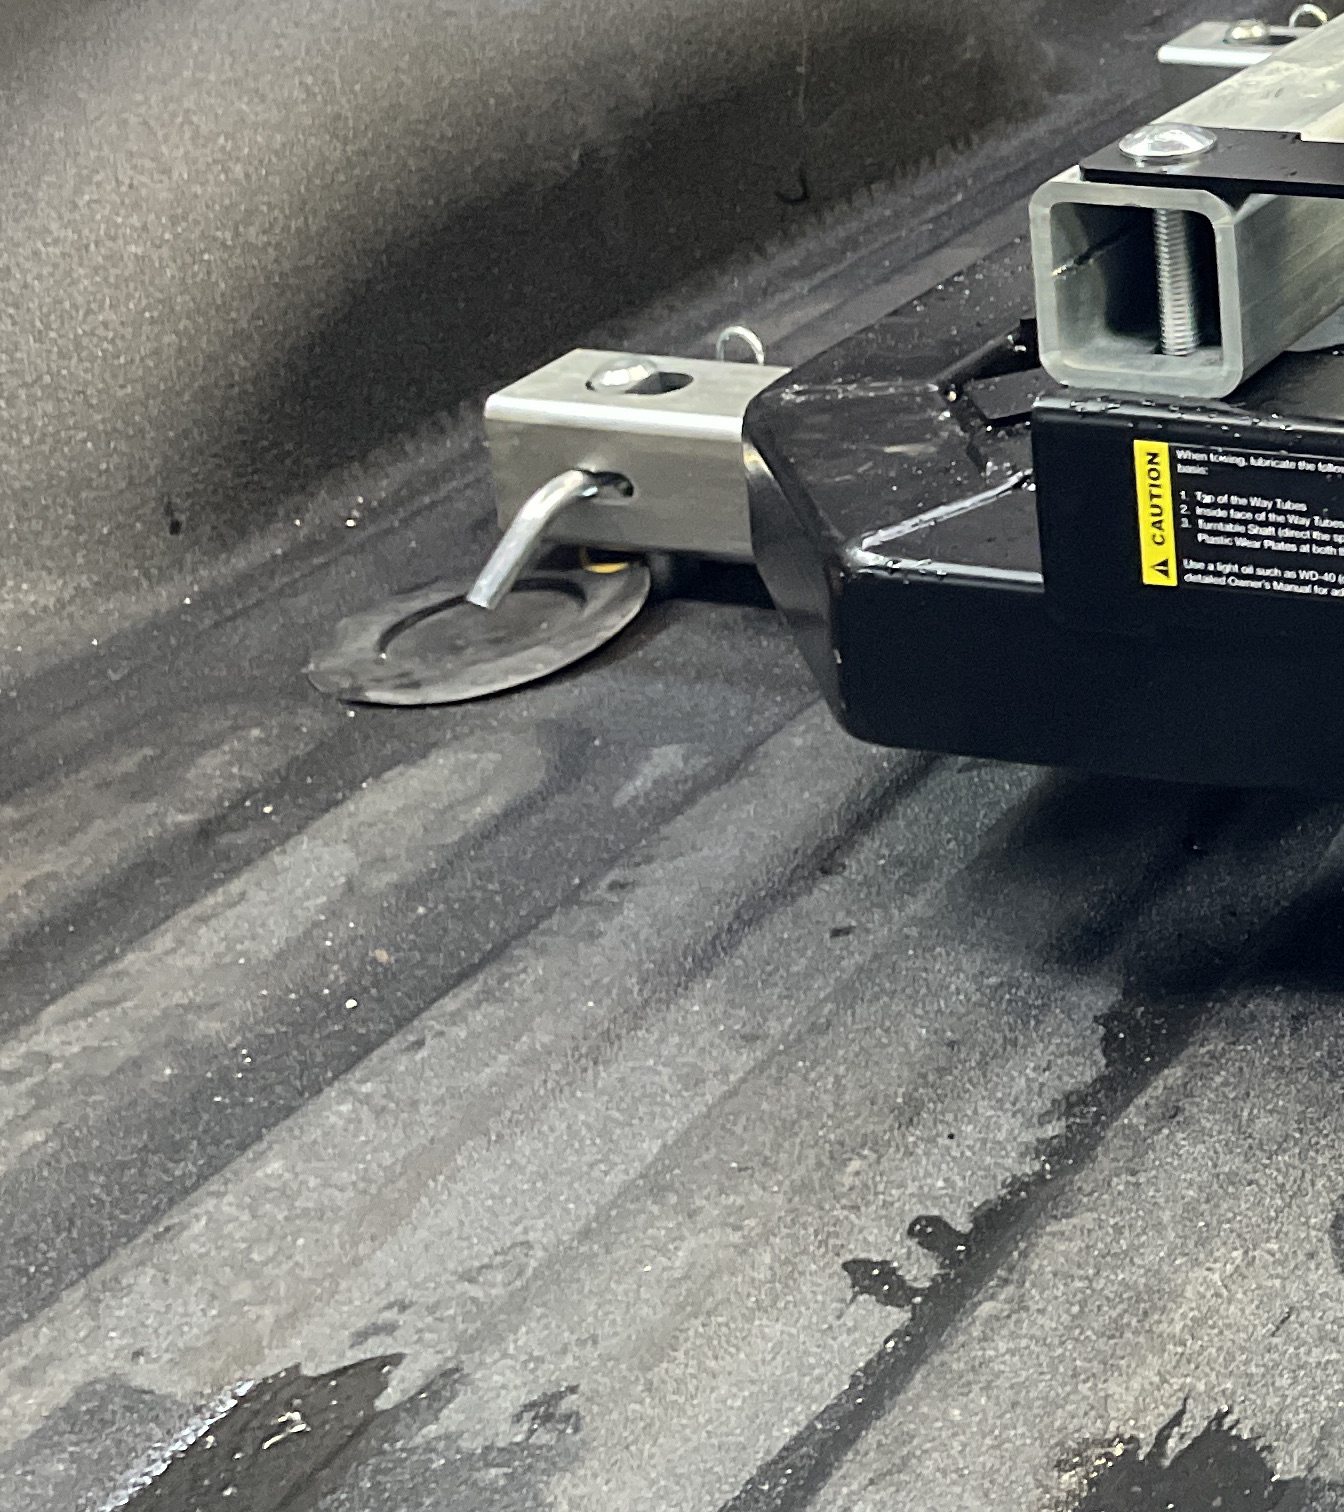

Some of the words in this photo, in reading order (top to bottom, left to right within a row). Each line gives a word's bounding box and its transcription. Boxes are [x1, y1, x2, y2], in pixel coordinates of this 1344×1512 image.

[1176, 449, 1208, 461] When
[1250, 456, 1296, 469] lubricate
[1298, 461, 1316, 471] the
[1146, 451, 1166, 547] CAUTION
[1179, 491, 1189, 501] 1.
[1217, 494, 1228, 503] of
[1230, 495, 1248, 505] the
[1249, 496, 1273, 510] Way
[1275, 498, 1307, 511] Tubes
[1179, 504, 1190, 515] 2.
[1230, 508, 1253, 520] face
[1255, 510, 1266, 521] of
[1267, 512, 1285, 523] the
[1287, 514, 1311, 527] Way
[1313, 515, 1344, 529] Tubes
[1198, 519, 1246, 533] Turntable
[1247, 524, 1276, 536] Shaft
[1277, 527, 1311, 539] (direct
[1312, 530, 1331, 541] the
[1197, 533, 1234, 546] Plastic
[1234, 536, 1261, 549] Wear
[1263, 539, 1297, 552] Plates
[1299, 543, 1310, 553] at
[1312, 543, 1337, 556] both
[1182, 558, 1205, 570] Use
[1207, 562, 1215, 571] a
[1216, 561, 1238, 574] light
[1241, 565, 1254, 574] oil
[1255, 566, 1281, 577] such
[1283, 569, 1297, 579] as
[1298, 569, 1336, 582] WD-40
[1272, 580, 1312, 594] Manual
[1313, 584, 1328, 595] for
